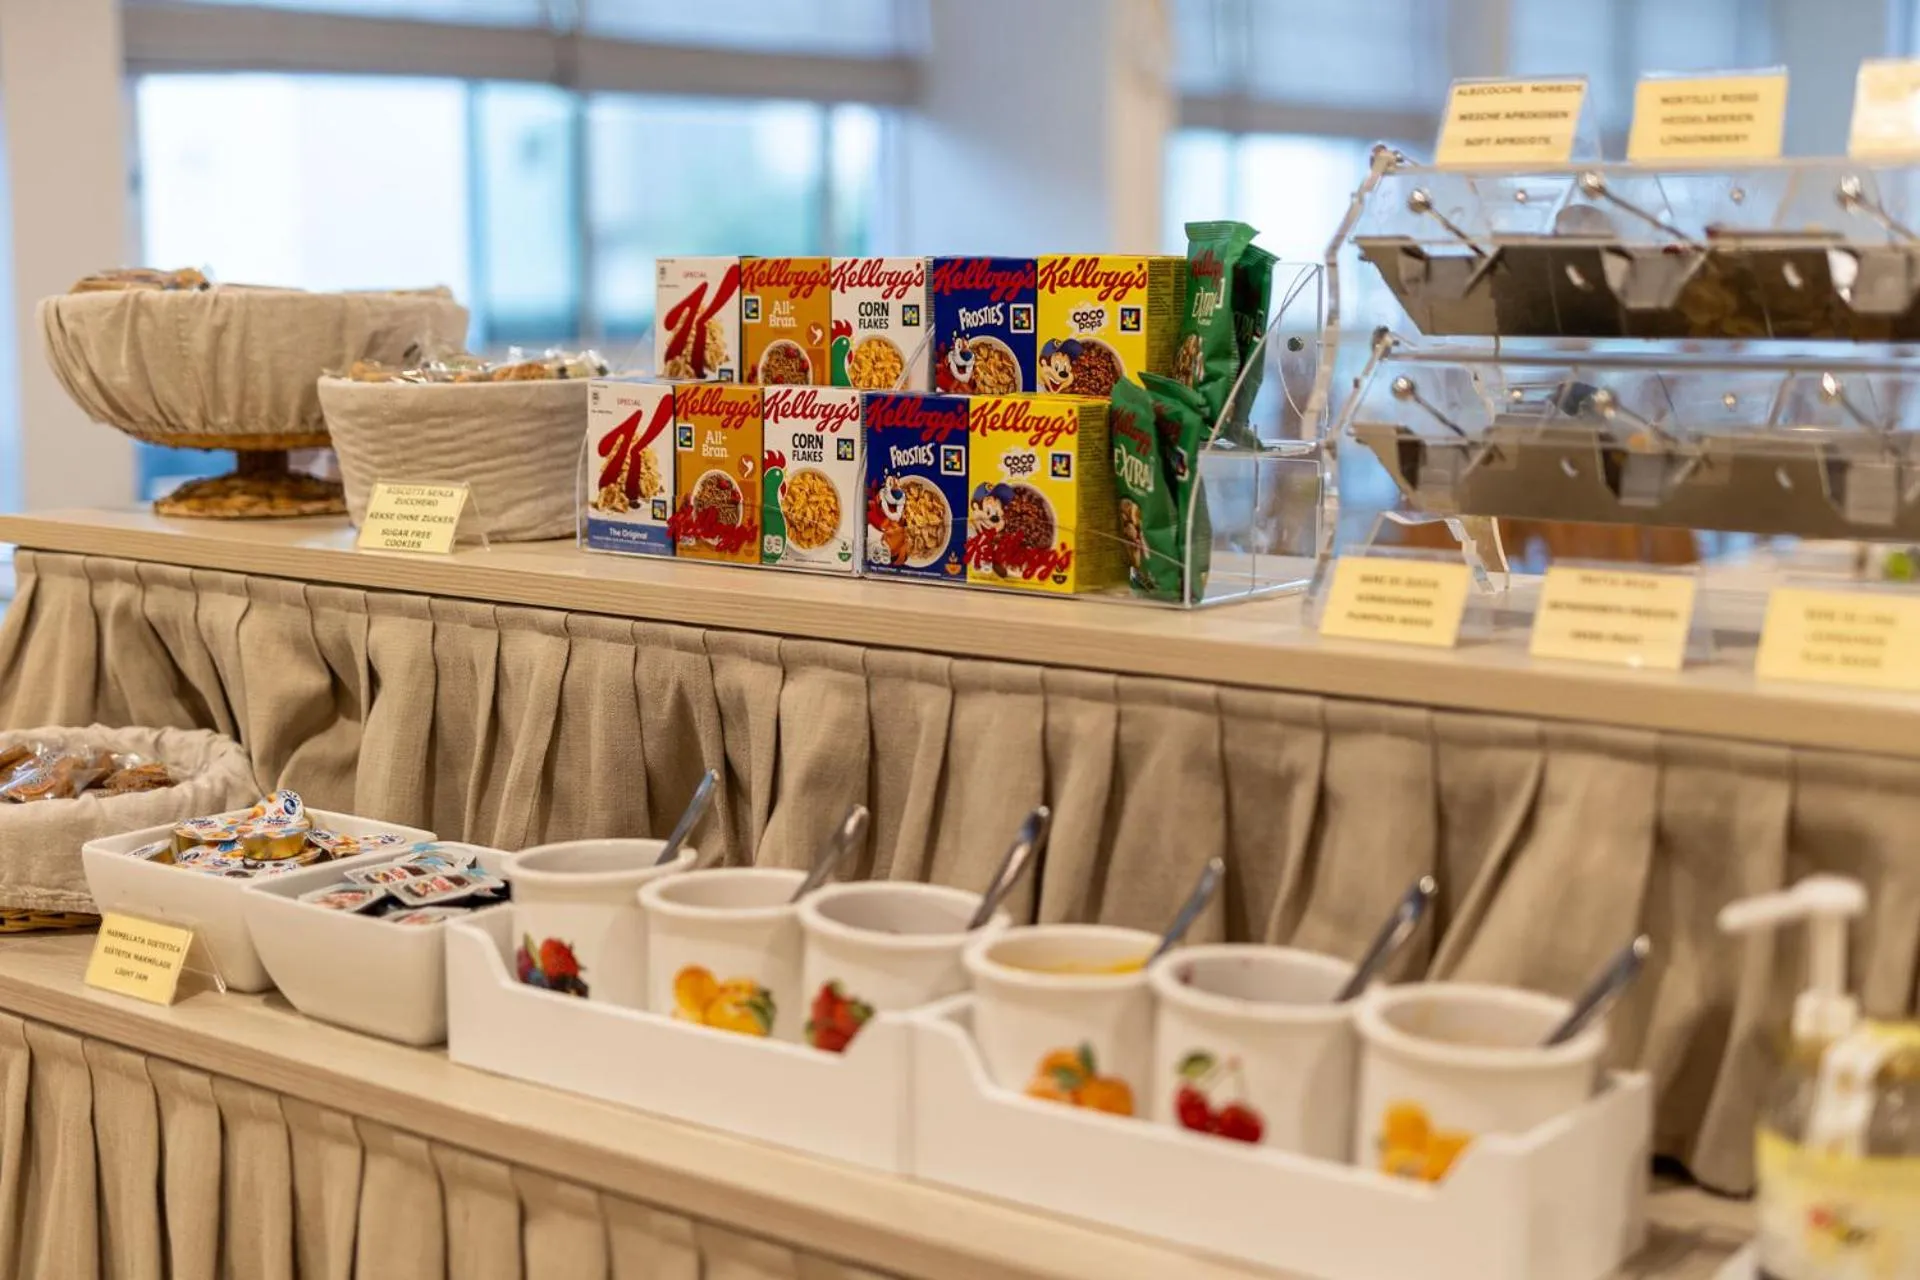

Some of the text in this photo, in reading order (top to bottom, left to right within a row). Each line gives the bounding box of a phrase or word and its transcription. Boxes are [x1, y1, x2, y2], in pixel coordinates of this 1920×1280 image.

[741, 259, 830, 298] Kellogg's
[831, 258, 924, 299] Kellogg's
[933, 257, 1036, 301] Kellogg's
[1038, 257, 1147, 301] Kellogg's
[772, 300, 796, 315] All-
[858, 302, 890, 317] CORN
[768, 314, 797, 328] Bran
[858, 318, 889, 330] FLAKES
[958, 303, 1005, 330] FROSTIES
[616, 398, 641, 407] SPECIAL
[675, 386, 761, 430] Kellogg's
[763, 388, 860, 433] Kellogg's
[866, 395, 969, 442] Kellogg's
[970, 399, 1079, 447] Kellogg's
[705, 430, 728, 445] All-
[792, 433, 824, 449] CORN
[702, 443, 729, 458] Bran
[792, 450, 824, 463] FLAKES
[889, 444, 935, 469] FROSTIES
[394, 497, 439, 507] ZUCCHERO
[368, 511, 455, 524] KEKSE OHNE ZUCKER
[380, 528, 432, 540] SUGAR FREE
[609, 526, 621, 537] The
[622, 528, 648, 541] Original
[384, 538, 422, 549] COOKIES
